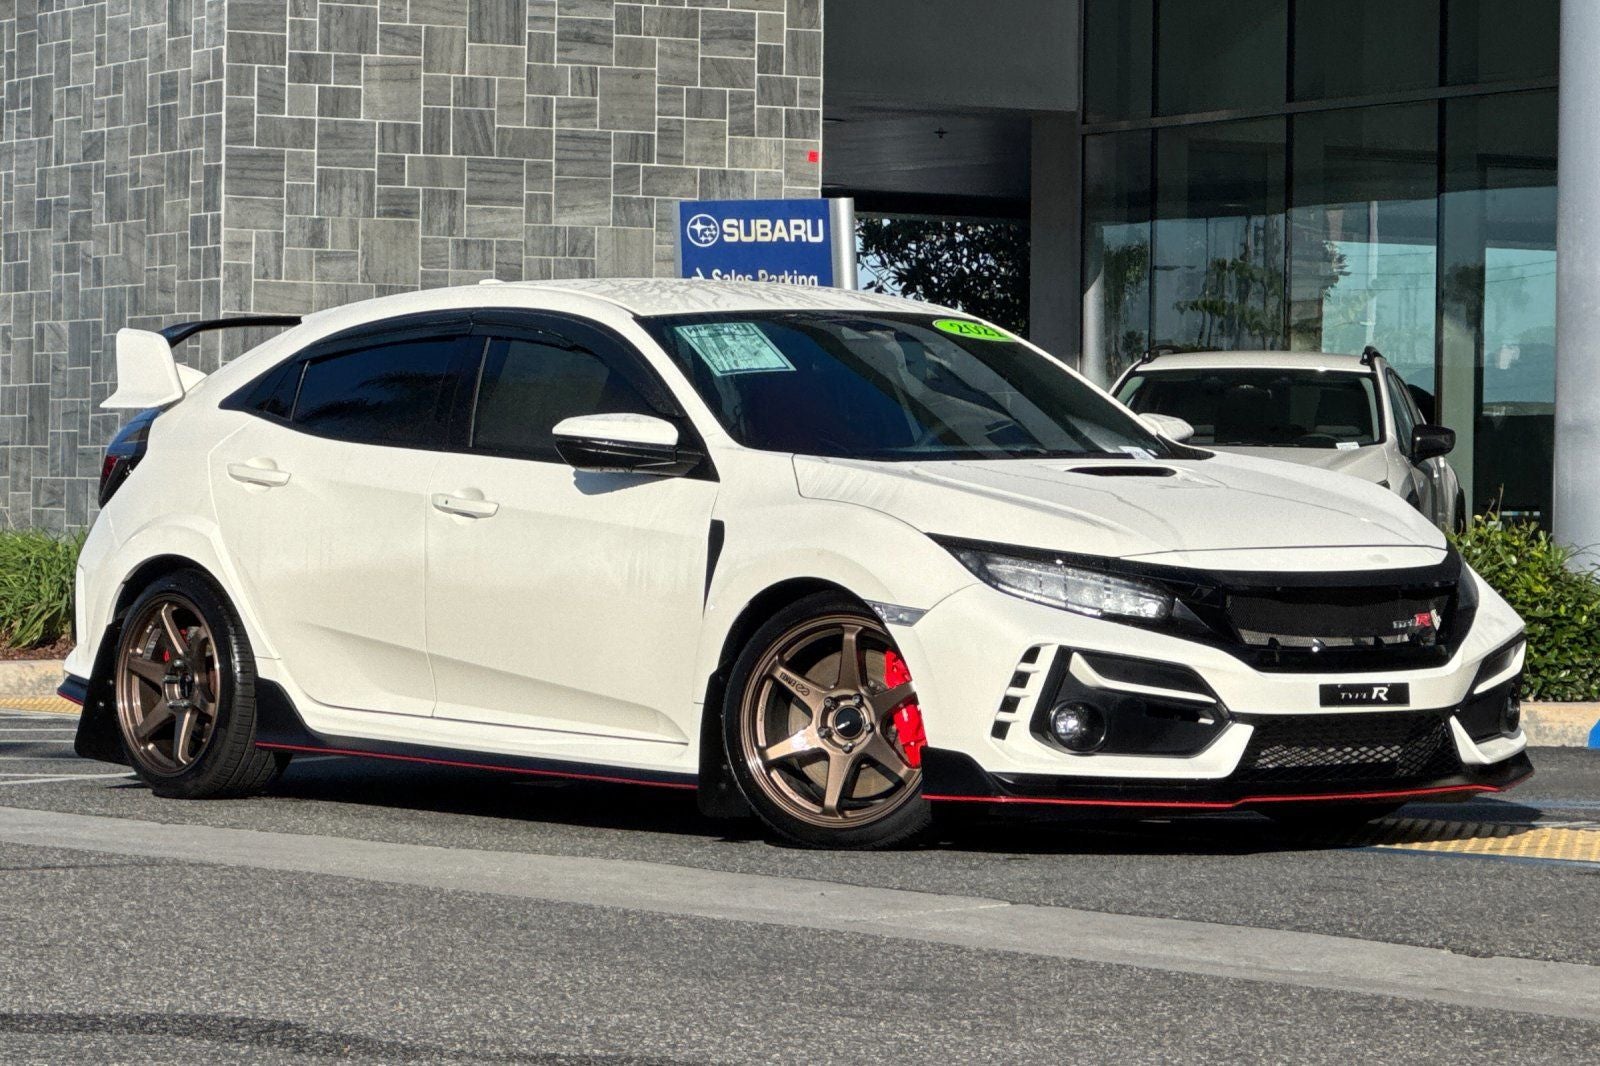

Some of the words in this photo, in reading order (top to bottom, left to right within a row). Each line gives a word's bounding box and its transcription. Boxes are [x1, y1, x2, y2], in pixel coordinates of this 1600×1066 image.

[722, 218, 824, 242] SUBARU
[711, 269, 753, 282] Sales
[758, 269, 818, 286] Parking
[1414, 612, 1431, 627] R
[1371, 687, 1389, 701] R
